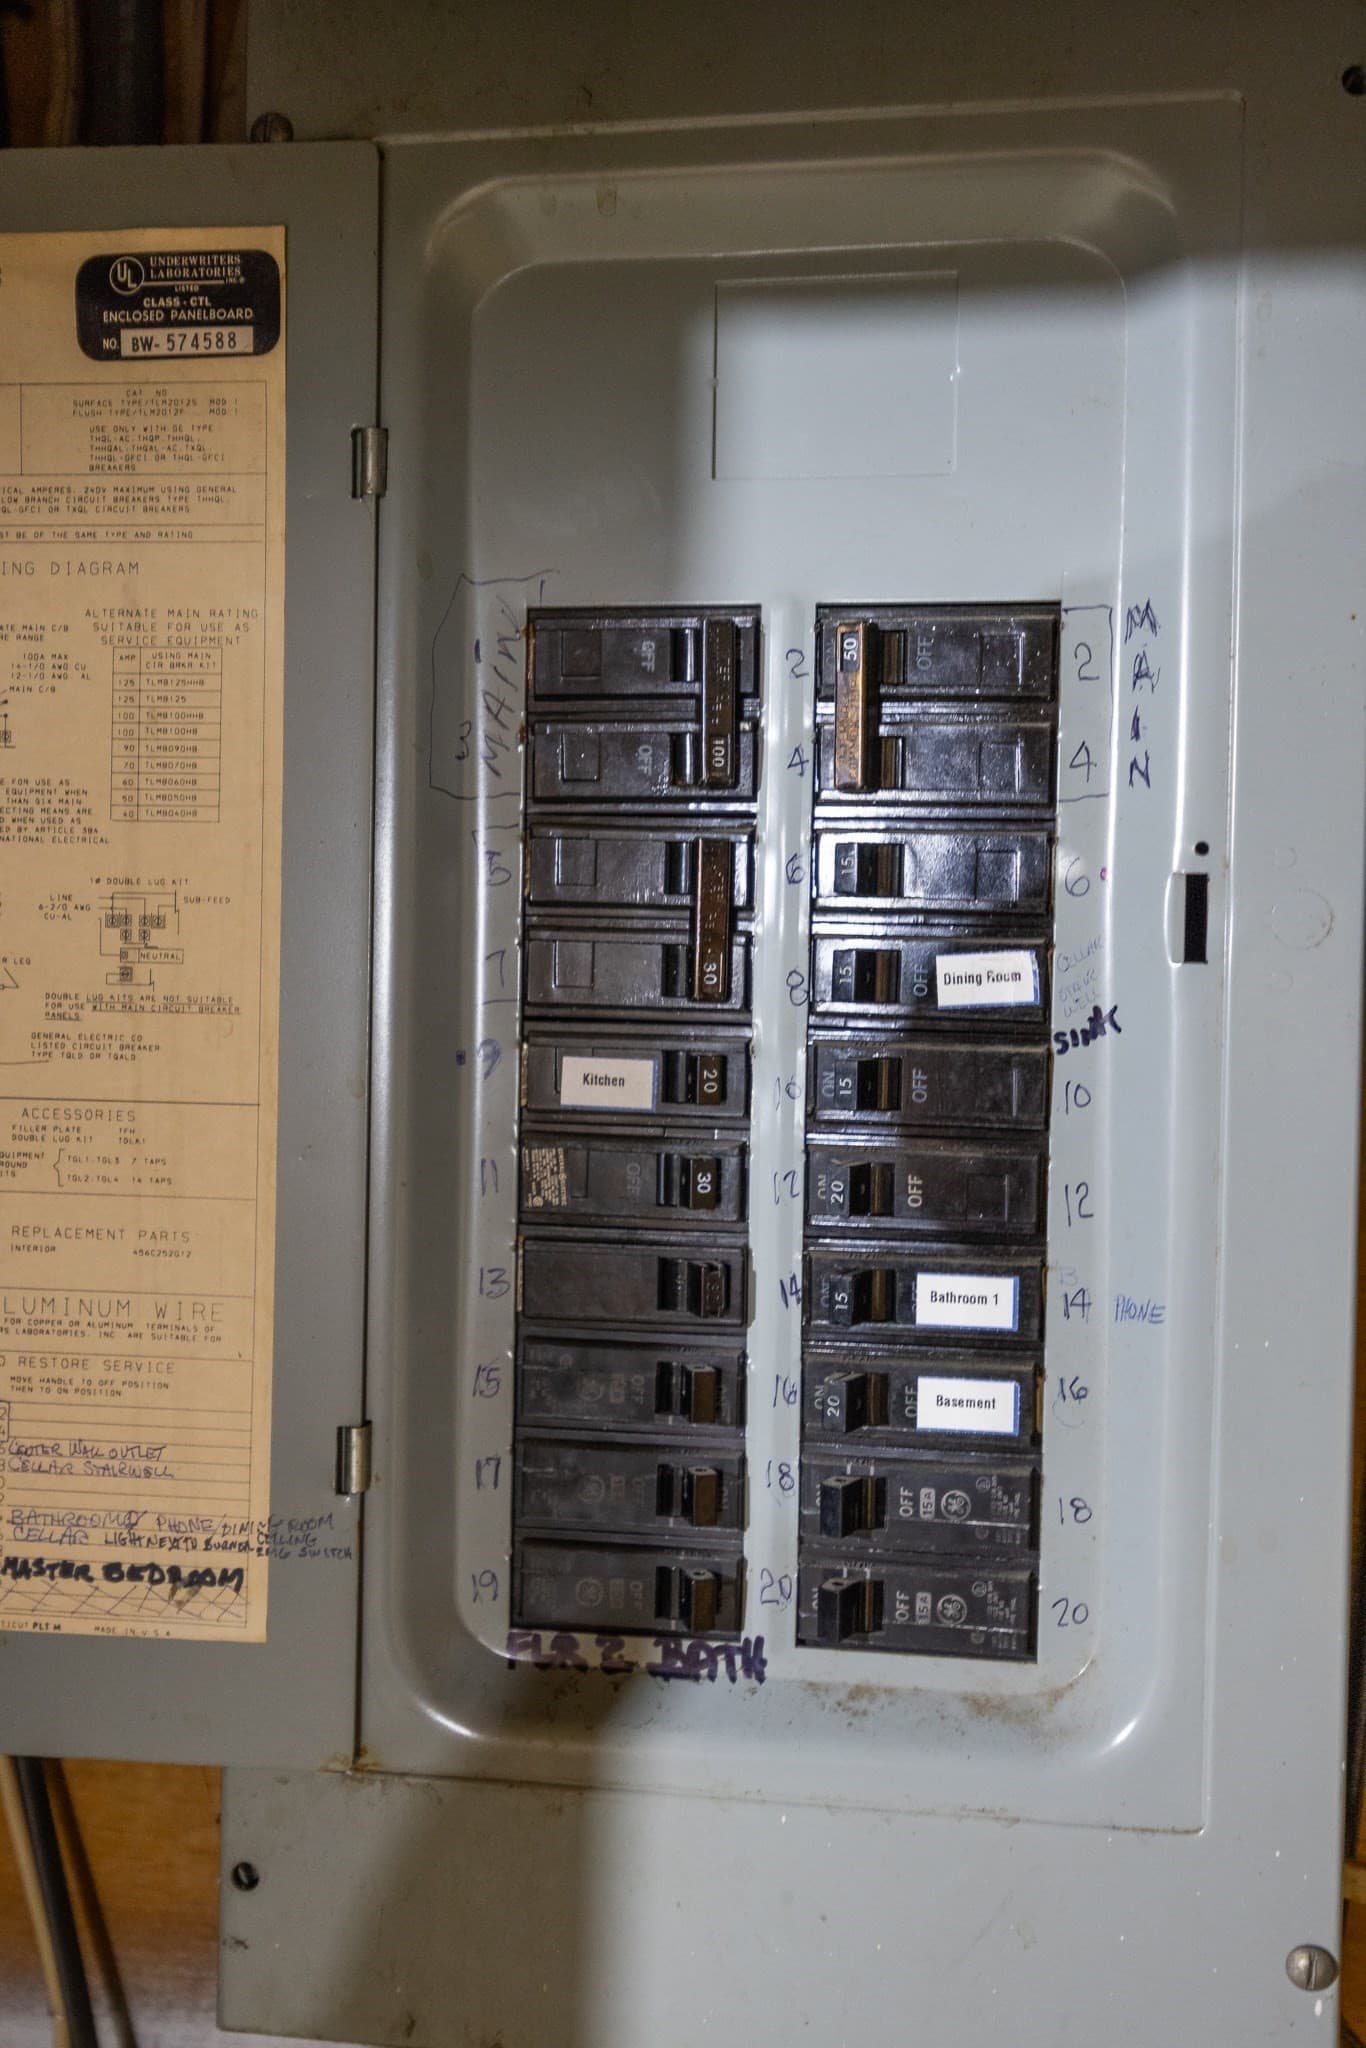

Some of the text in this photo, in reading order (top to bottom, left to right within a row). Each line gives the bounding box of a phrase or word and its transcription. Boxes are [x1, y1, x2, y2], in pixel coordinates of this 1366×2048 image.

[150, 255, 240, 266] UNDERWRITERS
[150, 267, 241, 279] LABORATORIES
[117, 263, 137, 288] UL
[103, 308, 253, 323] ENCLOSED PANELBOARD
[144, 296, 211, 307] CLASS CTL
[51, 561, 140, 575] DIAGRAM
[85, 609, 157, 618] ALTERNATE
[167, 609, 200, 618] MAIN
[93, 623, 249, 632] SUITABLE FOR USE AS
[101, 636, 241, 646] SERVICE EQUIPMENT
[843, 638, 857, 661] 50
[916, 636, 933, 671] OFF
[786, 649, 808, 678] 2
[1075, 642, 1100, 680] 2
[712, 740, 725, 768] 100
[788, 744, 809, 776] 4
[1069, 741, 1097, 782] 4
[485, 851, 511, 885] 5
[1065, 858, 1089, 895] 6
[703, 962, 717, 984] 30
[786, 969, 808, 1005] 8
[839, 966, 852, 984] 15
[913, 966, 928, 997] OFF
[944, 970, 1021, 986] Dining Room
[583, 1073, 625, 1087] Kitchen
[703, 1069, 718, 1093] 20
[839, 1078, 852, 1095] 15
[912, 1068, 928, 1103] OFF
[1066, 1080, 1091, 1115] 10
[22, 1108, 135, 1121] ACCESSORIES
[697, 1172, 710, 1193] 30
[831, 1180, 843, 1204] 20
[908, 1174, 923, 1208] OFF
[1066, 1182, 1093, 1226] 12
[12, 1226, 190, 1242] REPLACEMENT PARTS
[479, 1267, 510, 1297] 13
[154, 1301, 224, 1321] WIRE
[835, 1292, 848, 1310] 15
[930, 1290, 987, 1306] Bathroom
[993, 1293, 999, 1305] 1
[1063, 1289, 1092, 1324] 14
[1115, 1295, 1166, 1324] PHONE
[18, 1357, 175, 1373] RESTORE SERVICE
[473, 1363, 500, 1397] 15
[827, 1395, 840, 1417] 20
[906, 1384, 916, 1417] OFF
[936, 1395, 996, 1410] Basement
[109, 1443, 167, 1461] OUTLET
[476, 1458, 500, 1490] 17
[767, 1460, 794, 1490] 18
[899, 1487, 913, 1516] OFF
[921, 1489, 934, 1519] 15A
[1060, 1497, 1091, 1525] 18
[1, 1556, 245, 1592] MASTER BEDROOM
[472, 1570, 498, 1602] 19
[761, 1569, 791, 1603] 20
[896, 1591, 909, 1620] OFF
[1053, 1598, 1088, 1626] 20
